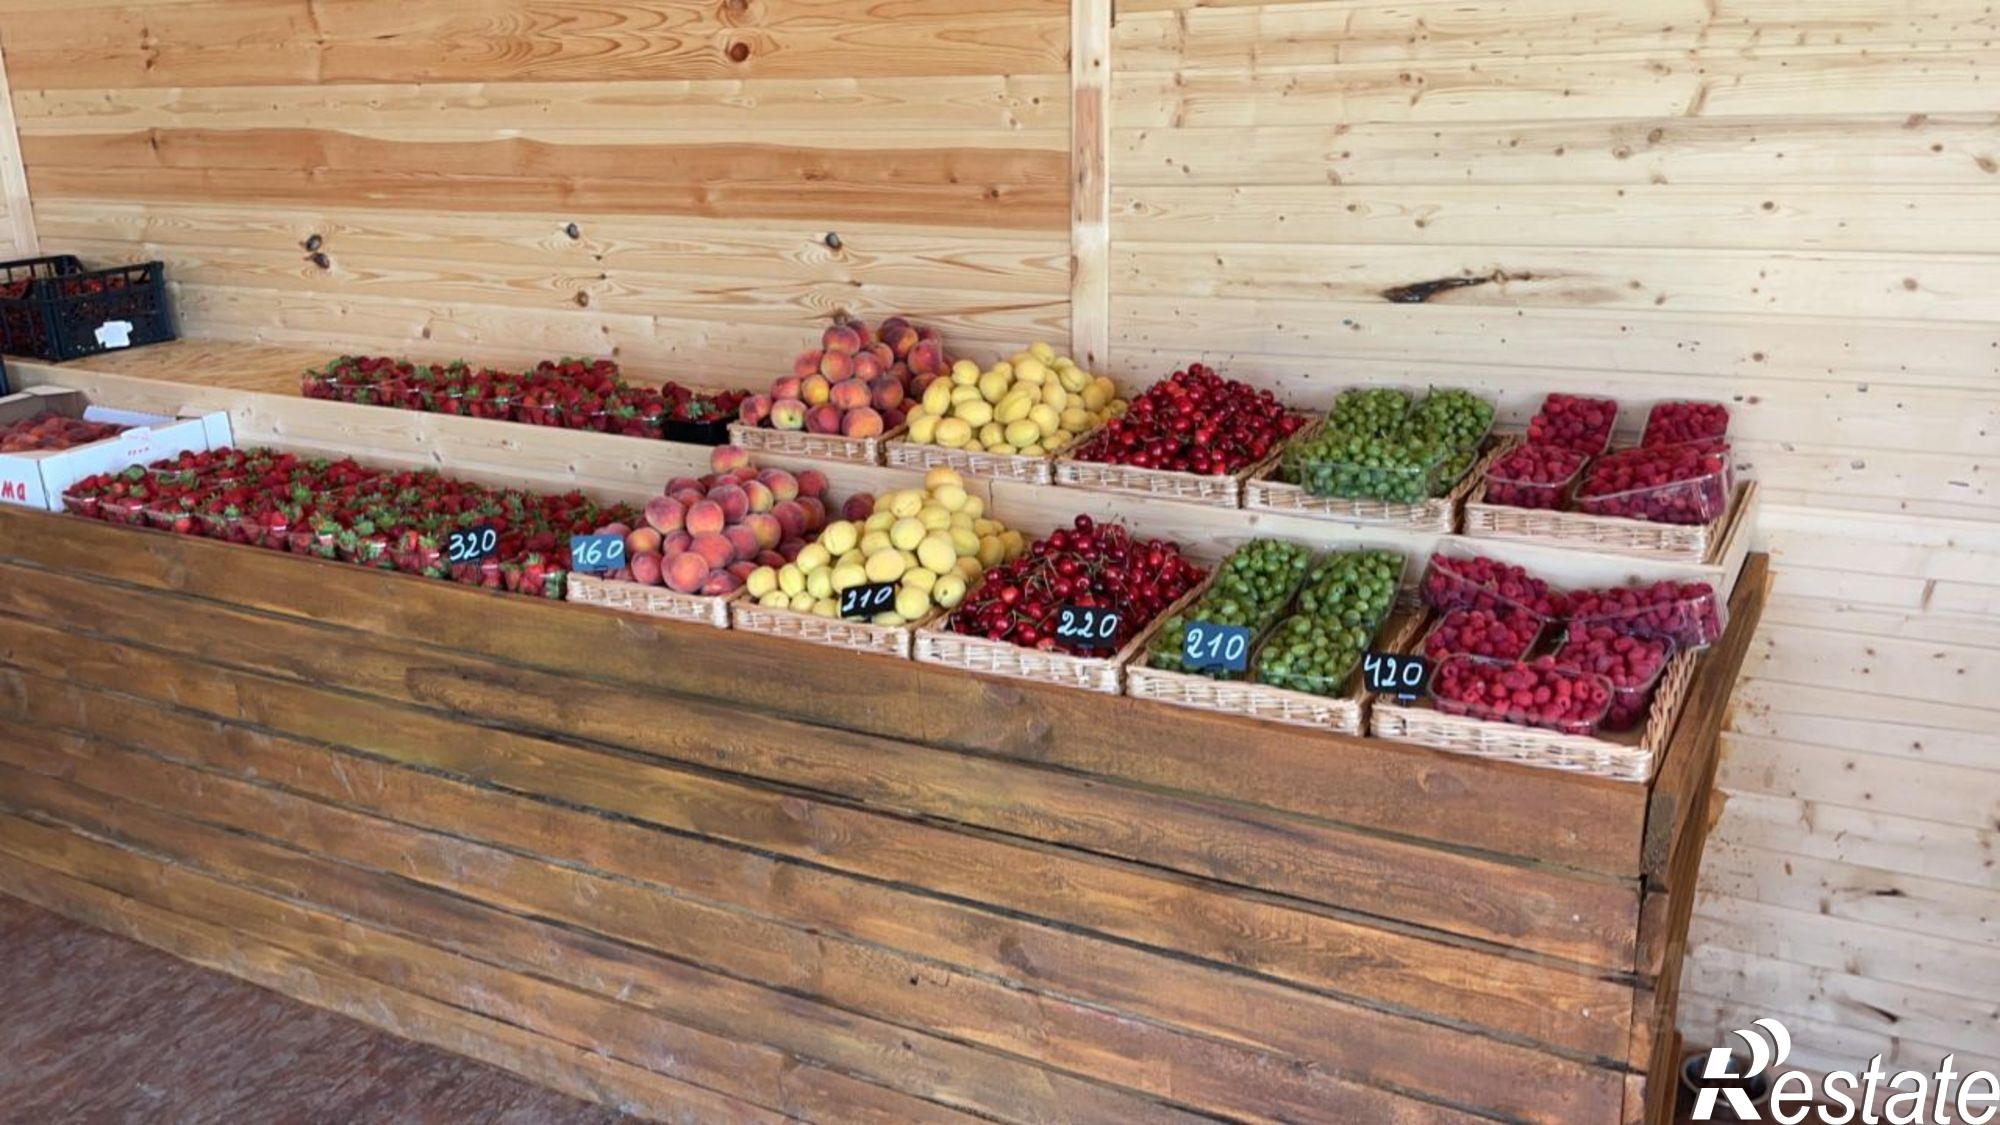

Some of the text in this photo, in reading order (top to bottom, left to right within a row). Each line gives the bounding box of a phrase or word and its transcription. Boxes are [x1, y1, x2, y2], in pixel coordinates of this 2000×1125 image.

[449, 529, 497, 561] 320
[842, 585, 893, 612] 210
[1057, 611, 1118, 638] 220
[1186, 629, 1246, 659] 210
[1364, 656, 1424, 688] 420
